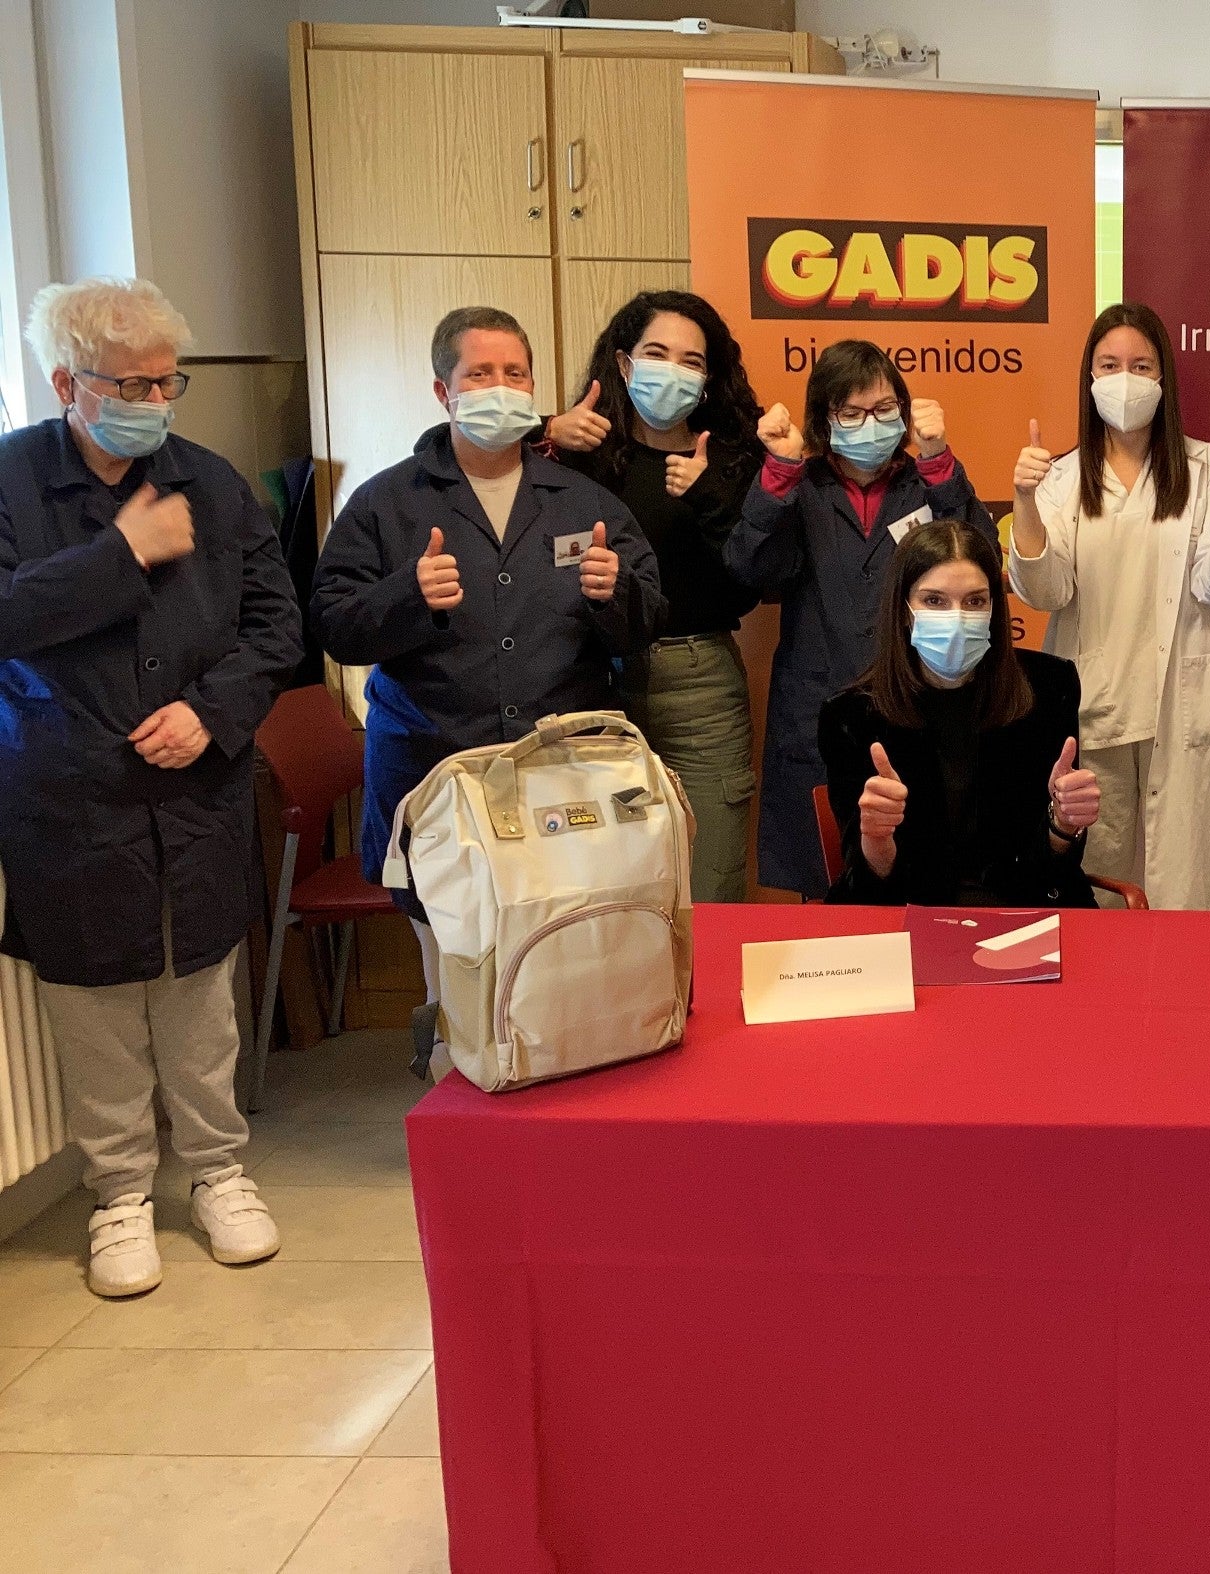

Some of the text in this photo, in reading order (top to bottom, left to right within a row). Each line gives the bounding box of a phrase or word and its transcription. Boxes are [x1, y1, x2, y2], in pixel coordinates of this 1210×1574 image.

[762, 229, 1039, 310] GADIS
[784, 337, 1023, 374] bienidos
[570, 815, 596, 825] GADIS
[797, 970, 824, 979] MELISA
[825, 967, 863, 976] PAGLIARO
